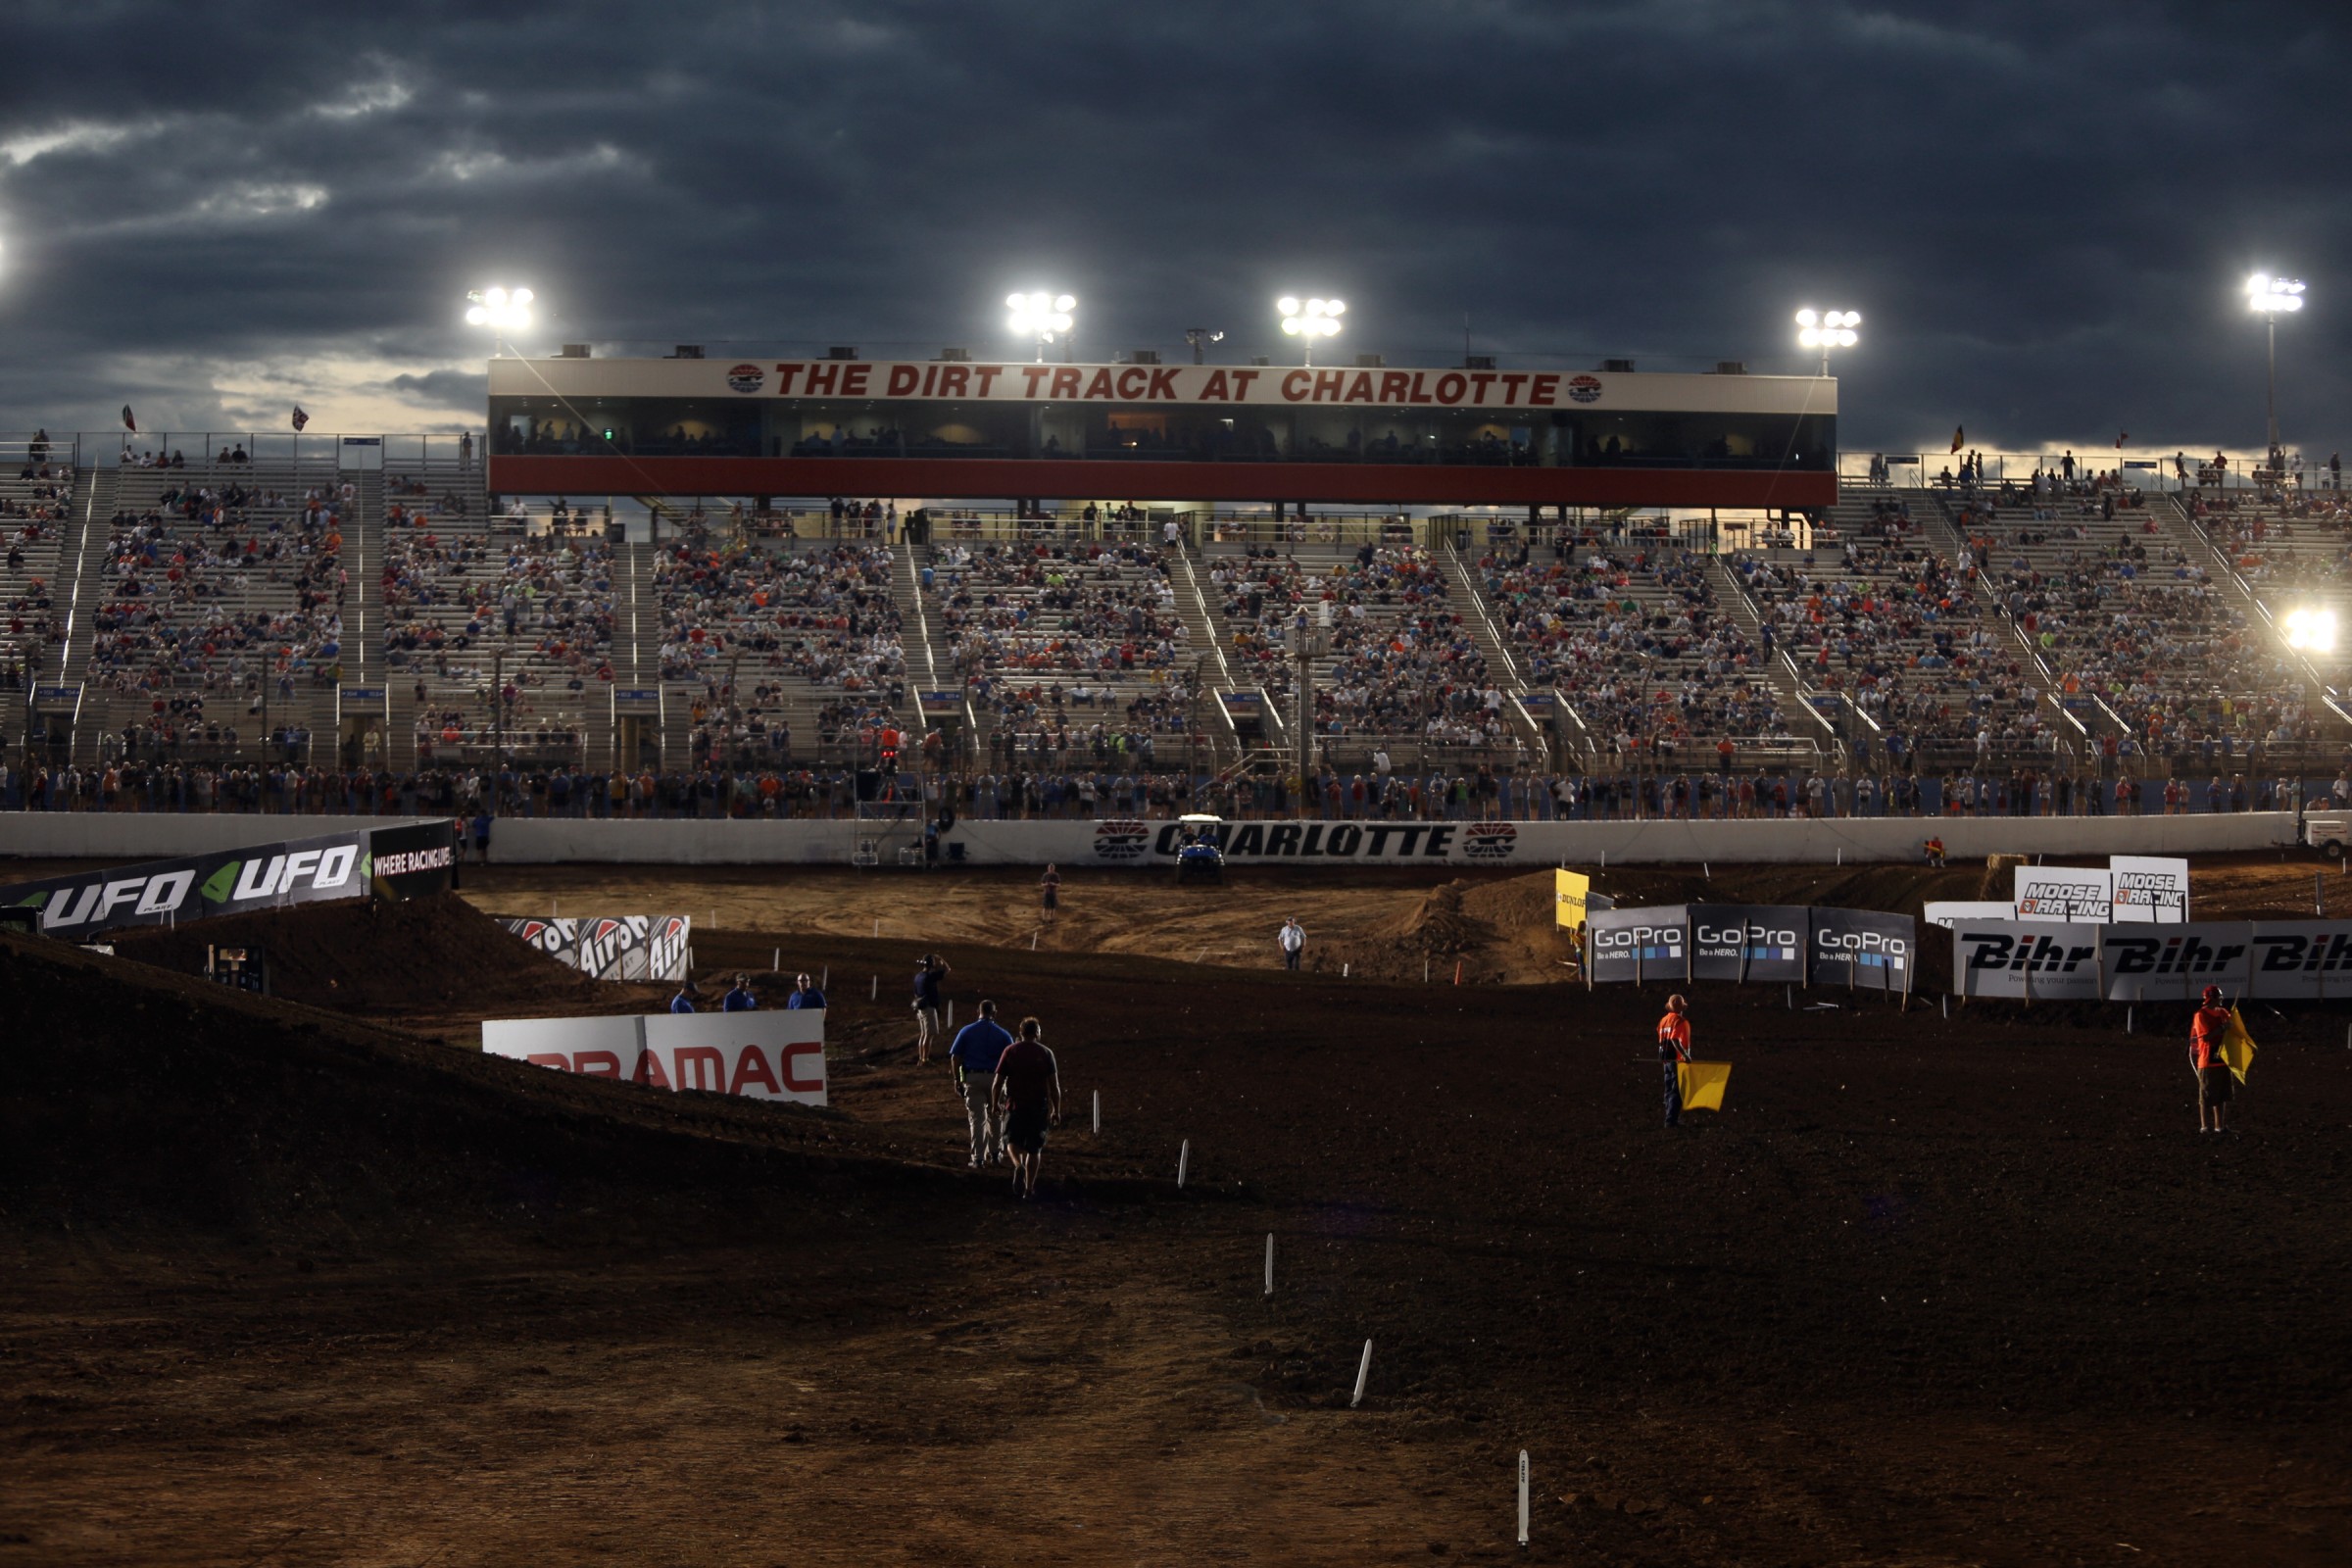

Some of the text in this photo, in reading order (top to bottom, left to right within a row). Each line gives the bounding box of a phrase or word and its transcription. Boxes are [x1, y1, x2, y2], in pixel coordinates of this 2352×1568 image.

[776, 364, 1560, 405] THE DIRT TRACK AT CHARLOTTE
[373, 853, 407, 877] WHERE
[408, 849, 438, 872] RACING
[437, 846, 451, 867] LIVES
[233, 844, 359, 901] UFO
[2119, 872, 2176, 890] MOOSE
[43, 869, 196, 929] UFO
[2025, 882, 2101, 900] MOOSE
[2127, 889, 2185, 907] RACING
[2034, 899, 2111, 916] RACING
[1594, 926, 1682, 947] GoPro
[1697, 925, 1795, 945] GoPro
[1819, 929, 1906, 955] GoPro
[1699, 948, 1708, 956] Be
[1819, 952, 1829, 960] Be
[1961, 933, 2095, 972] Bihr
[2105, 937, 2246, 973] Bihr
